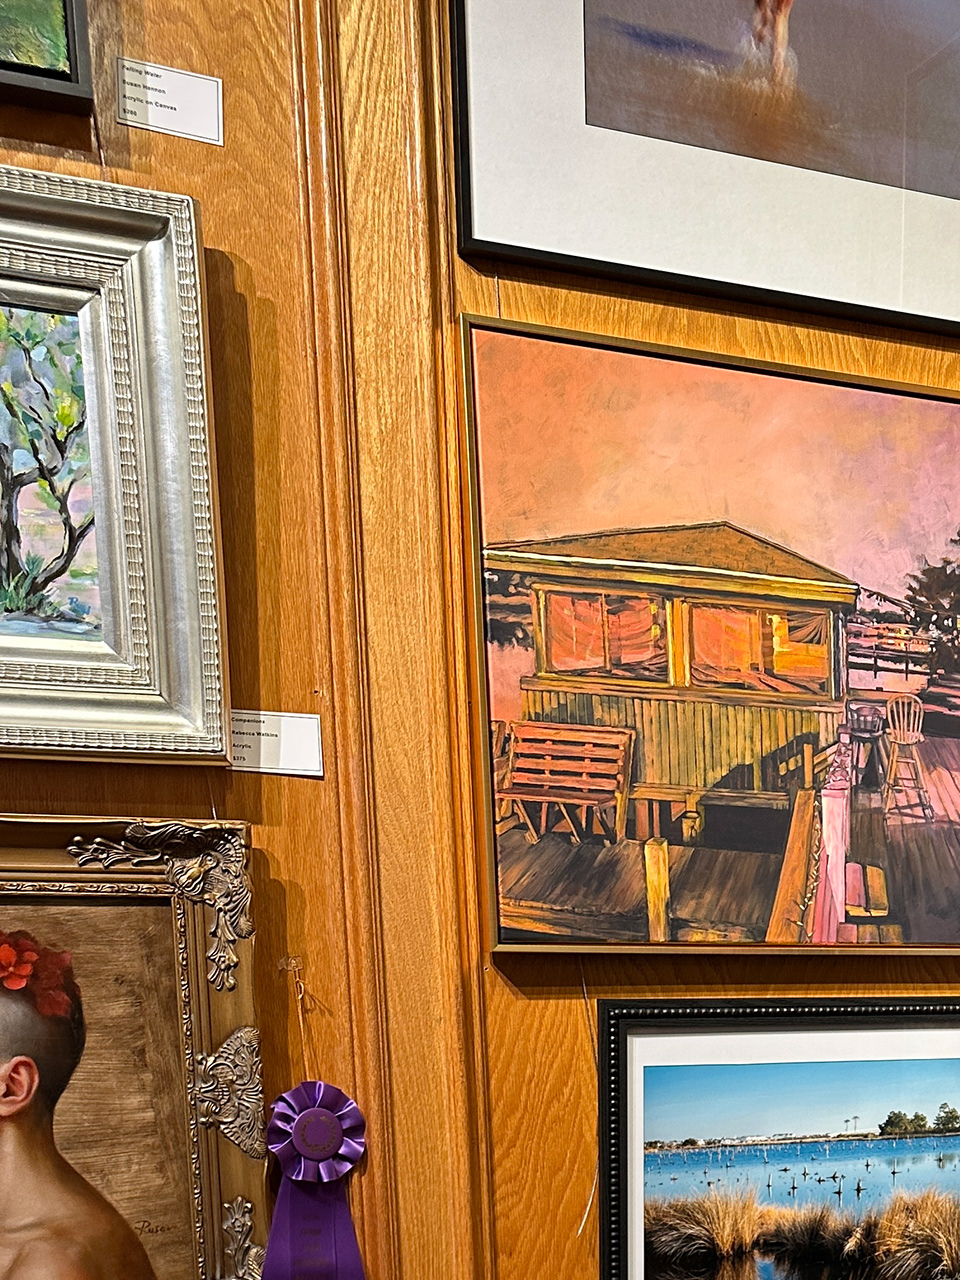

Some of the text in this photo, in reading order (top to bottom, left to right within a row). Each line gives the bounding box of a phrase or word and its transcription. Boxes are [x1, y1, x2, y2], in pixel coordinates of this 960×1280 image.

[122, 64, 163, 79] Falling Water
[122, 94, 144, 105] Acrylic
[154, 101, 177, 112] Canvas
[231, 729, 255, 737] Rebecca
